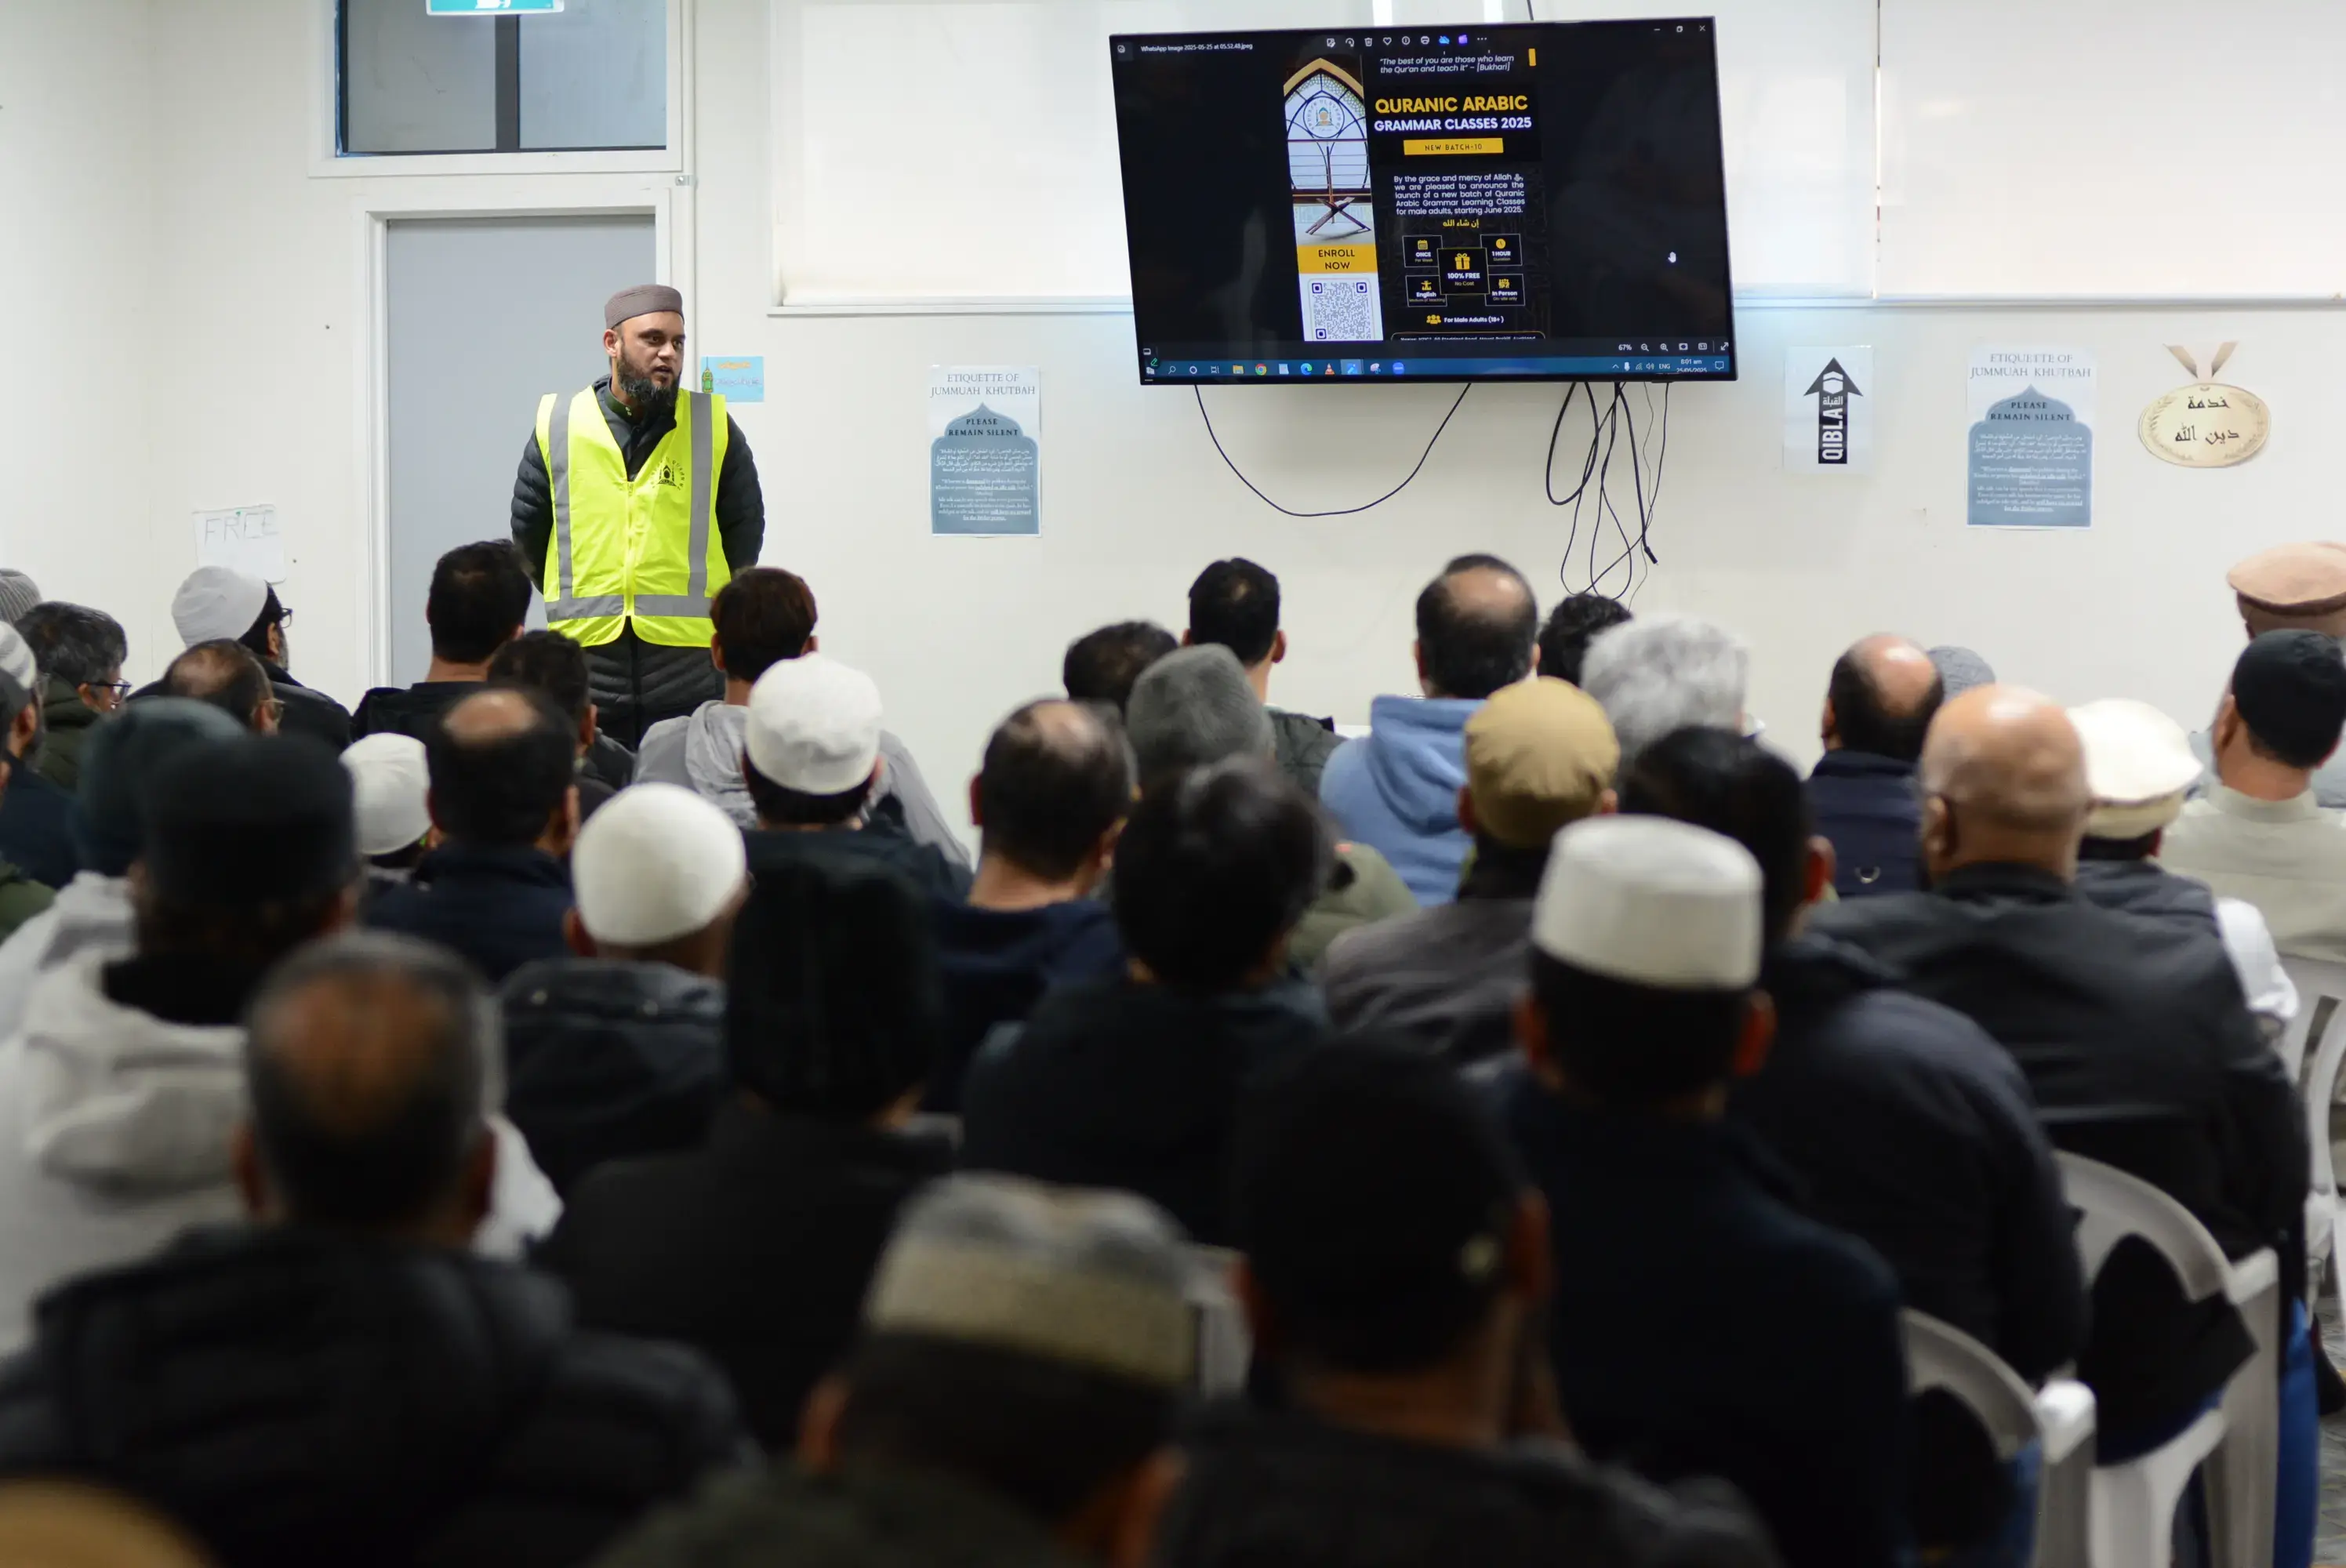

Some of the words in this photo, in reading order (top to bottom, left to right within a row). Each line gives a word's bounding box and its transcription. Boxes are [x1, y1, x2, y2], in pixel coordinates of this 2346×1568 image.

[1425, 57, 1440, 66] you
[1476, 63, 1510, 72] [Bukhari]
[1375, 97, 1458, 114] QURANIC
[1462, 95, 1528, 111] ARABIC
[1374, 119, 1442, 132] GRAMMAR
[1444, 118, 1498, 130] CLASSES
[1501, 117, 1532, 129] 2025
[1462, 198, 1494, 207] Learning
[1454, 207, 1483, 216] starting
[1443, 219, 1455, 227] الله
[1456, 219, 1469, 227] شاء
[1990, 354, 2054, 364] ETIQUETTE
[2057, 354, 2073, 363] OF
[947, 373, 1004, 383] ETIQUETTE
[1005, 373, 1020, 382] OF
[1970, 367, 2028, 379] JUMMUAH
[2035, 368, 2091, 378] KHUTBAH
[930, 386, 981, 398] JUMMUAH
[986, 386, 1036, 395] KHUTBAH
[1823, 395, 1843, 407] القبلة
[2188, 395, 2231, 409] خدمة
[1821, 407, 1843, 460] QIBLA
[2174, 423, 2197, 442] الله
[2205, 429, 2239, 445] دين
